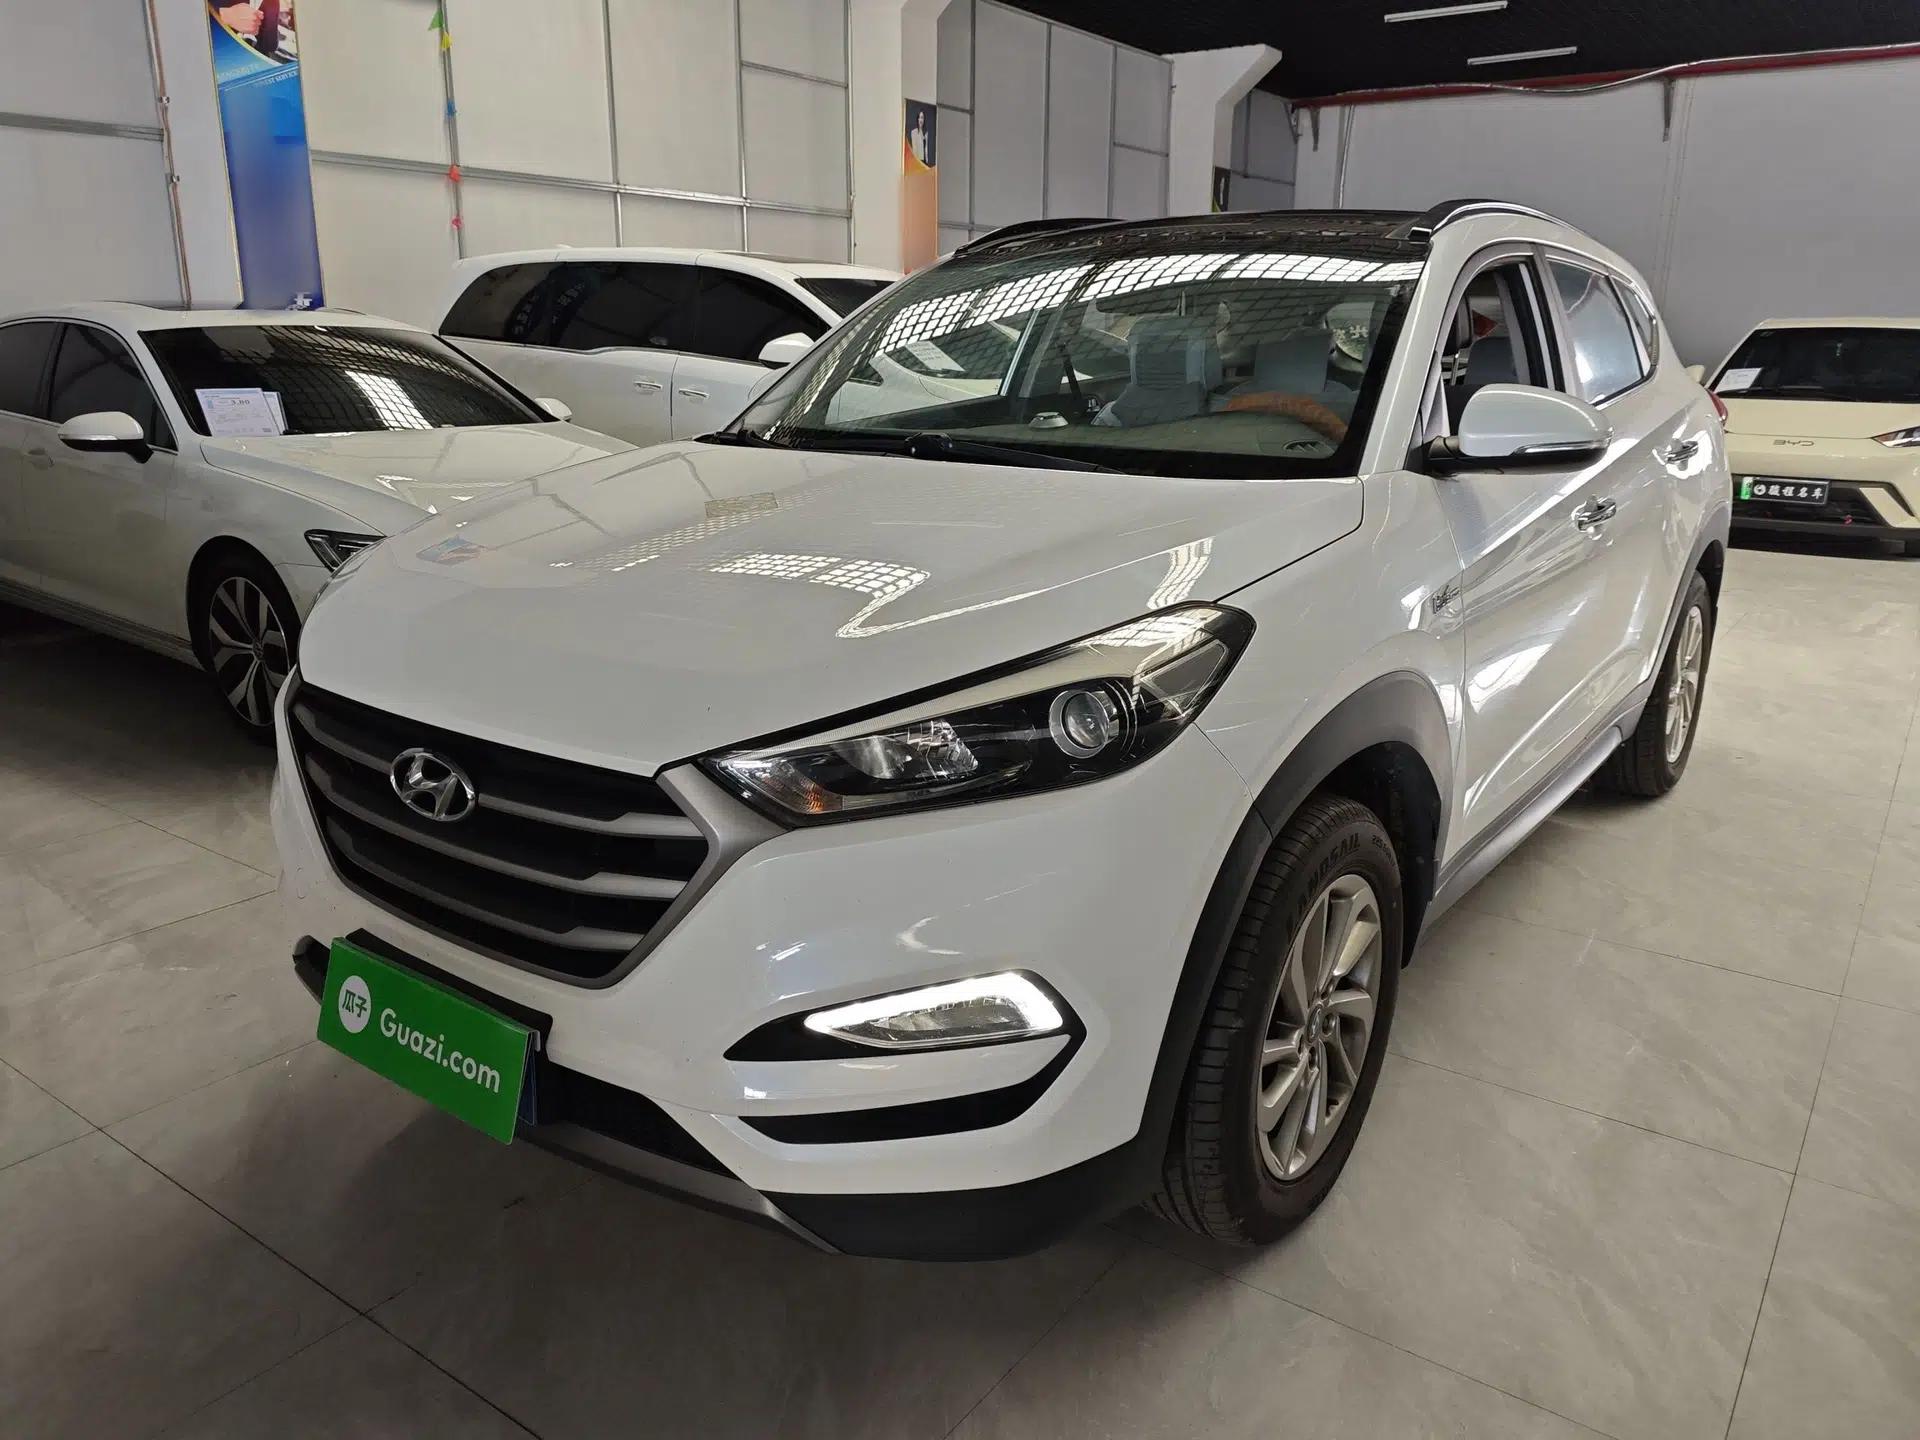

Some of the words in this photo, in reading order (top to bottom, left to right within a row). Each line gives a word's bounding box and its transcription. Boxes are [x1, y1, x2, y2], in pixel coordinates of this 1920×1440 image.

[1773, 439, 1815, 447] BYD
[342, 988, 368, 1019] 瓜子
[379, 1007, 501, 1093] Guazi.com
